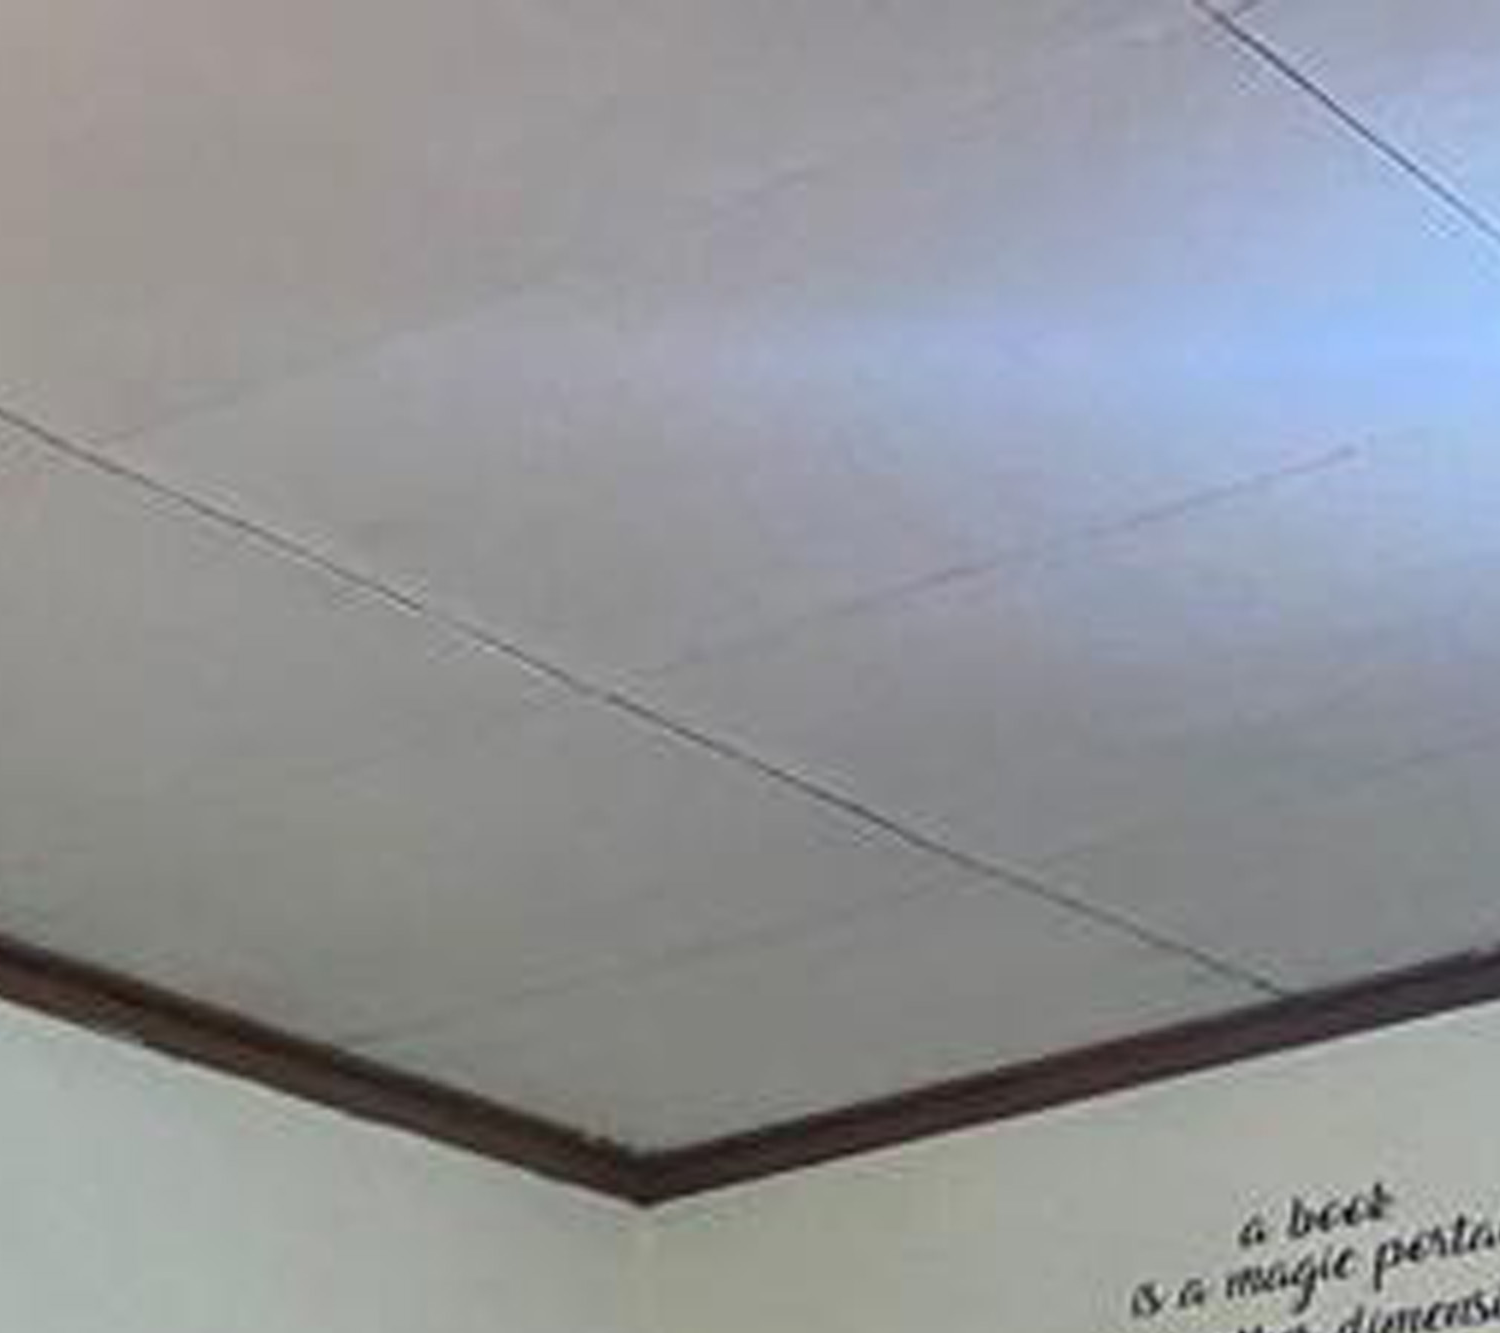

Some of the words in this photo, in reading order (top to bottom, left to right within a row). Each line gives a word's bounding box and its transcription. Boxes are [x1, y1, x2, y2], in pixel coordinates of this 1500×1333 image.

[1237, 1215, 1266, 1249] a
[1288, 1181, 1395, 1239] book
[1177, 1277, 1207, 1309] a
[1226, 1246, 1357, 1316] magic
[1372, 1214, 1500, 1292] porta
